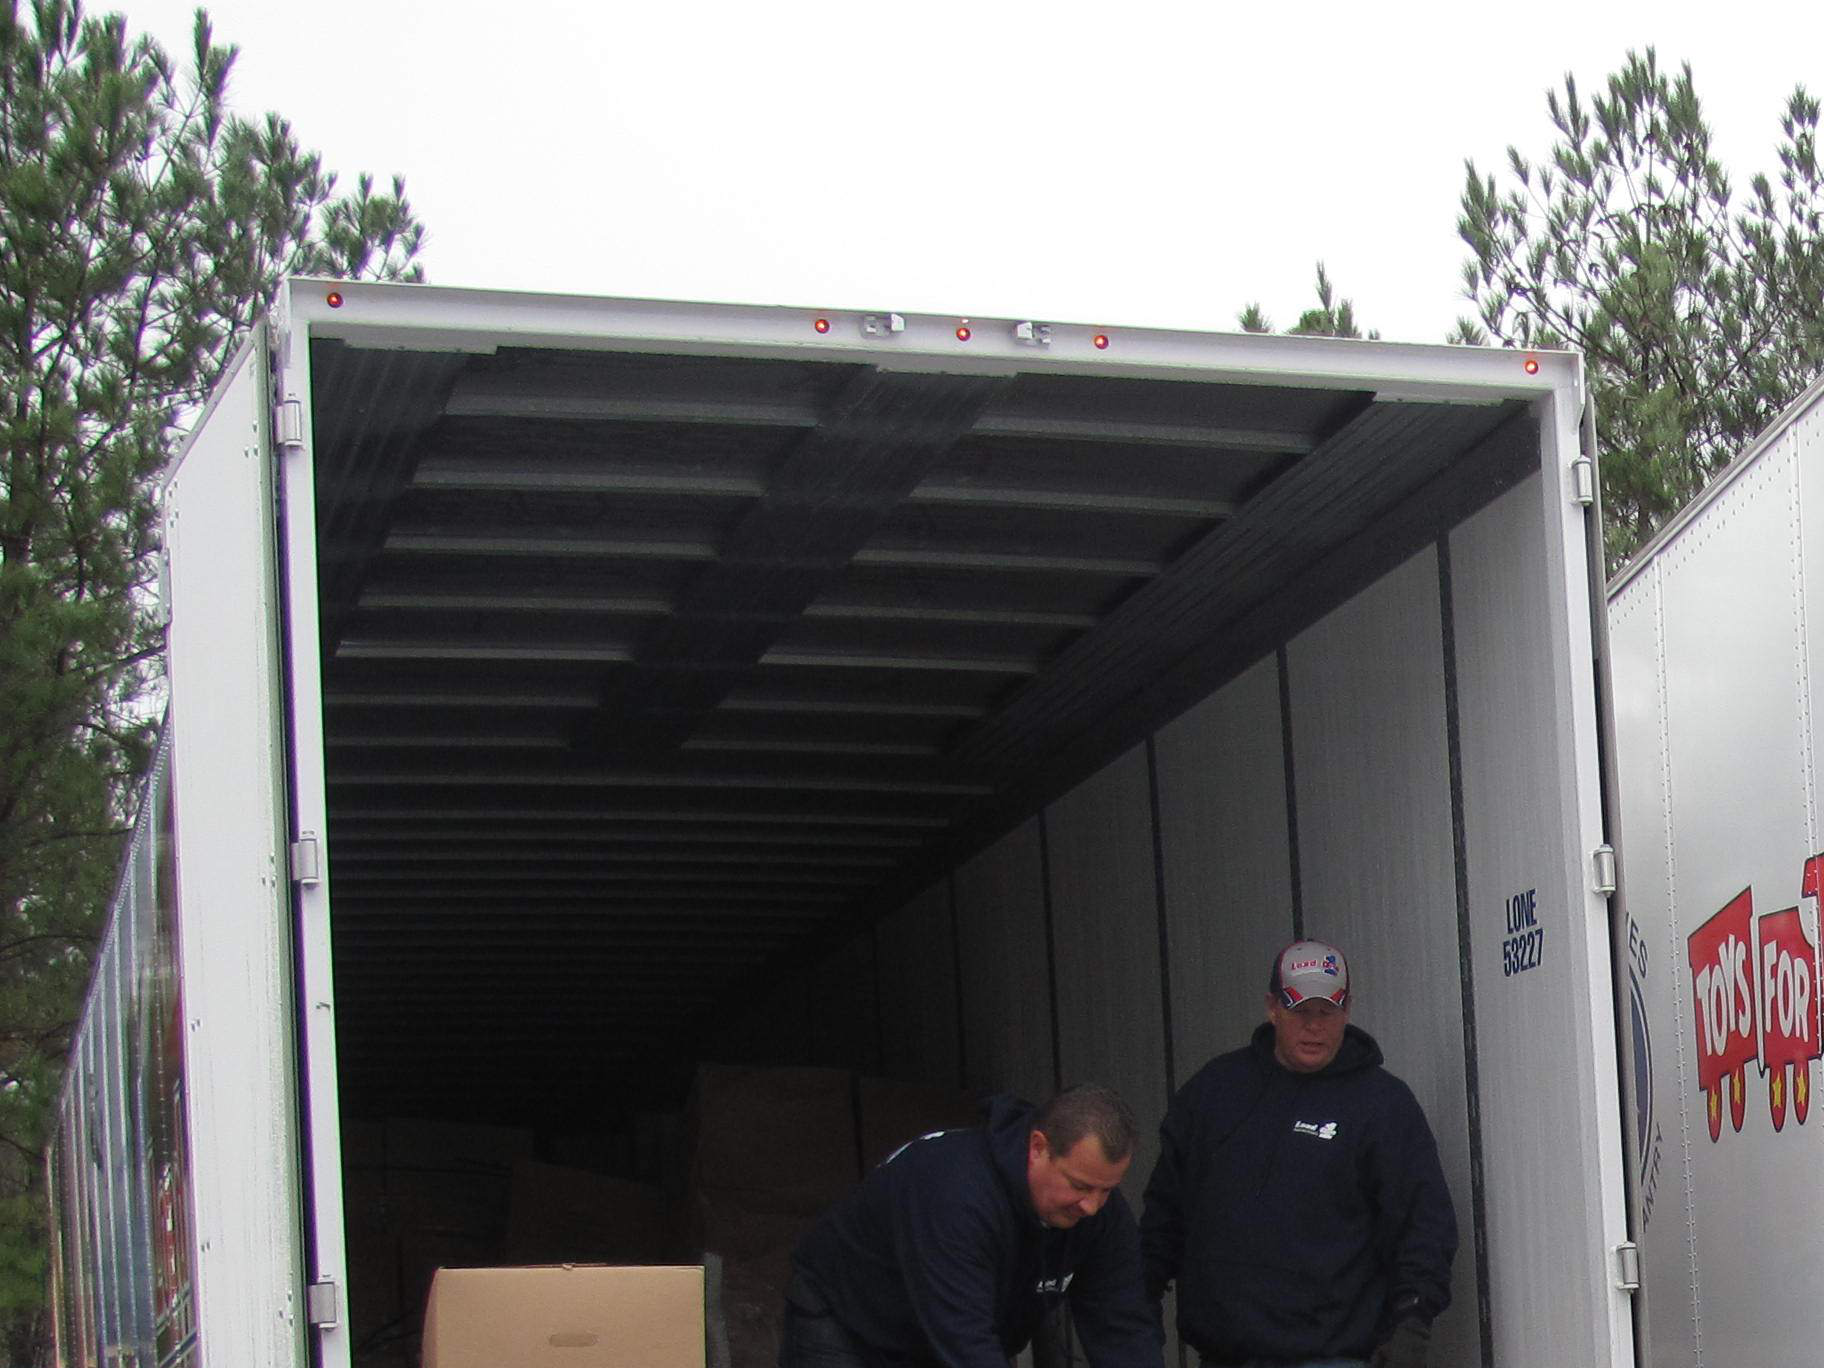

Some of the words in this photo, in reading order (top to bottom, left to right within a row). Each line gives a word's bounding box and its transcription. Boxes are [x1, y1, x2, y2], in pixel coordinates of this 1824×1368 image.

[1505, 888, 1537, 934] LONE
[1503, 928, 1544, 977] 53227
[1626, 911, 1648, 978] ES
[1697, 934, 1751, 1056] TOYS
[1764, 940, 1810, 1043] FOR
